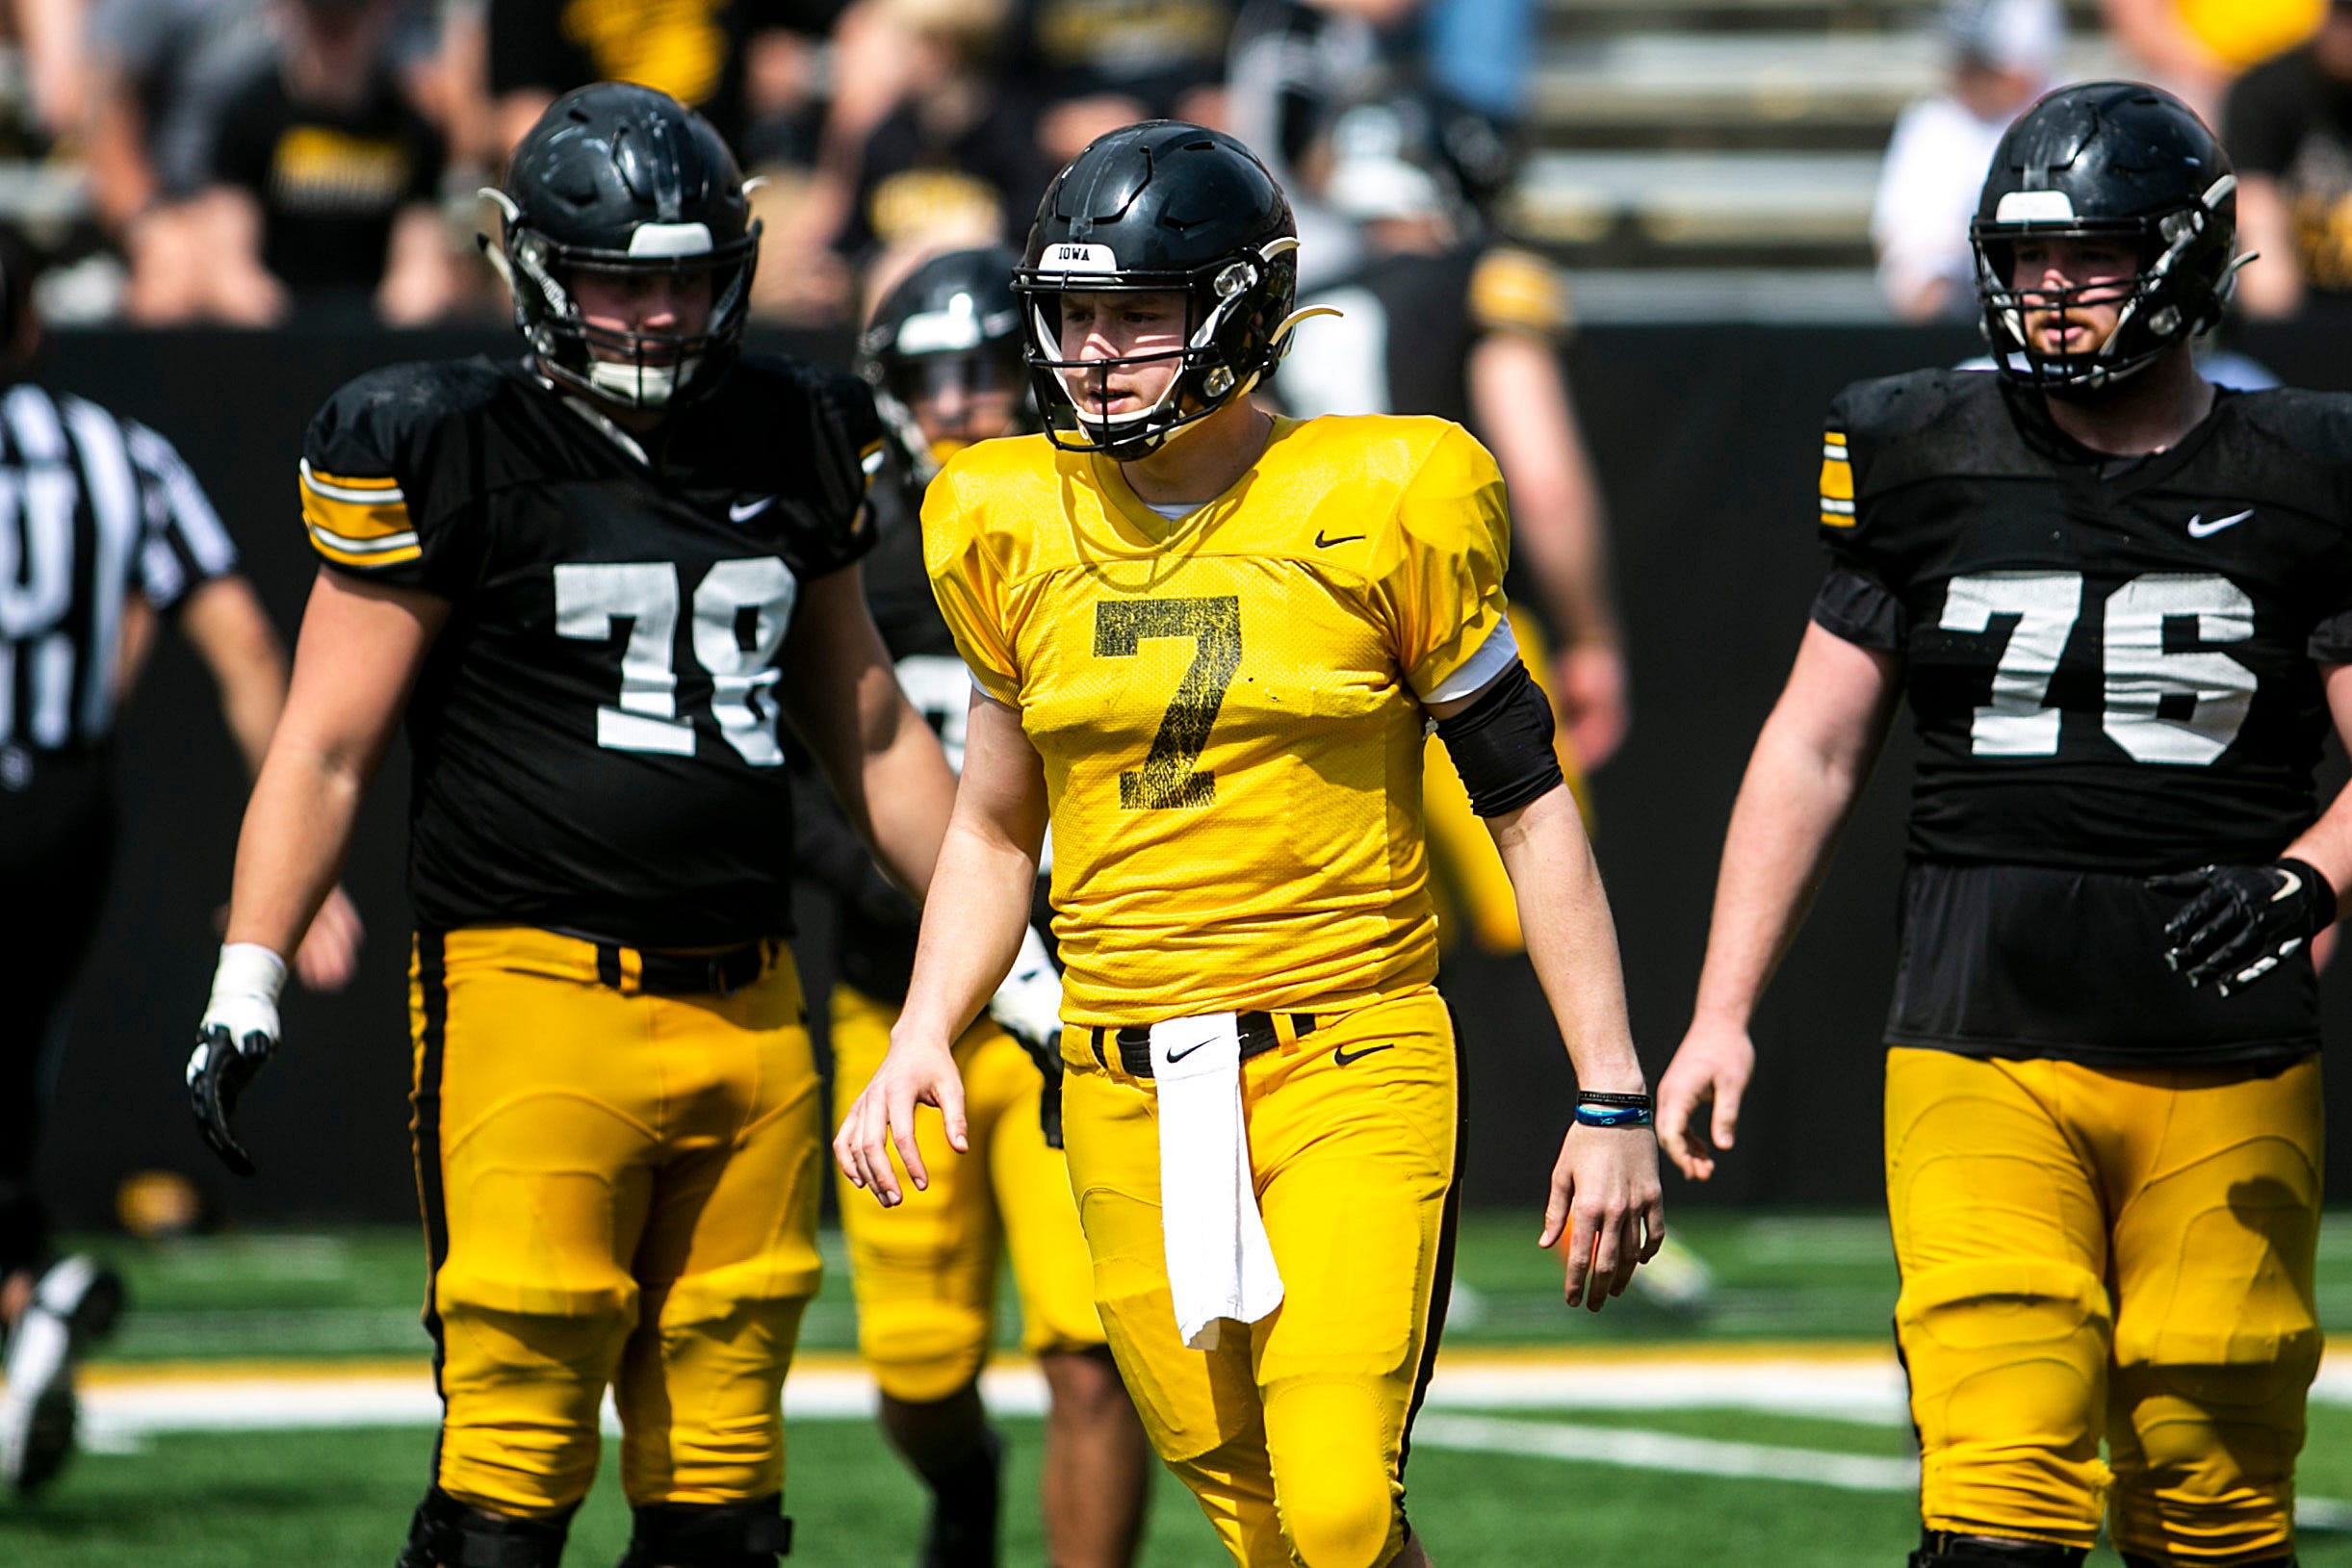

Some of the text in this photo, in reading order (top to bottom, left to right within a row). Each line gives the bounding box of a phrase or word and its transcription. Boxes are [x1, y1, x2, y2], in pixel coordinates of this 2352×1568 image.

[1058, 246, 1091, 261] IOWA
[554, 555, 797, 766] 78
[1094, 596, 1242, 809] 7
[1939, 570, 2259, 766] 76
